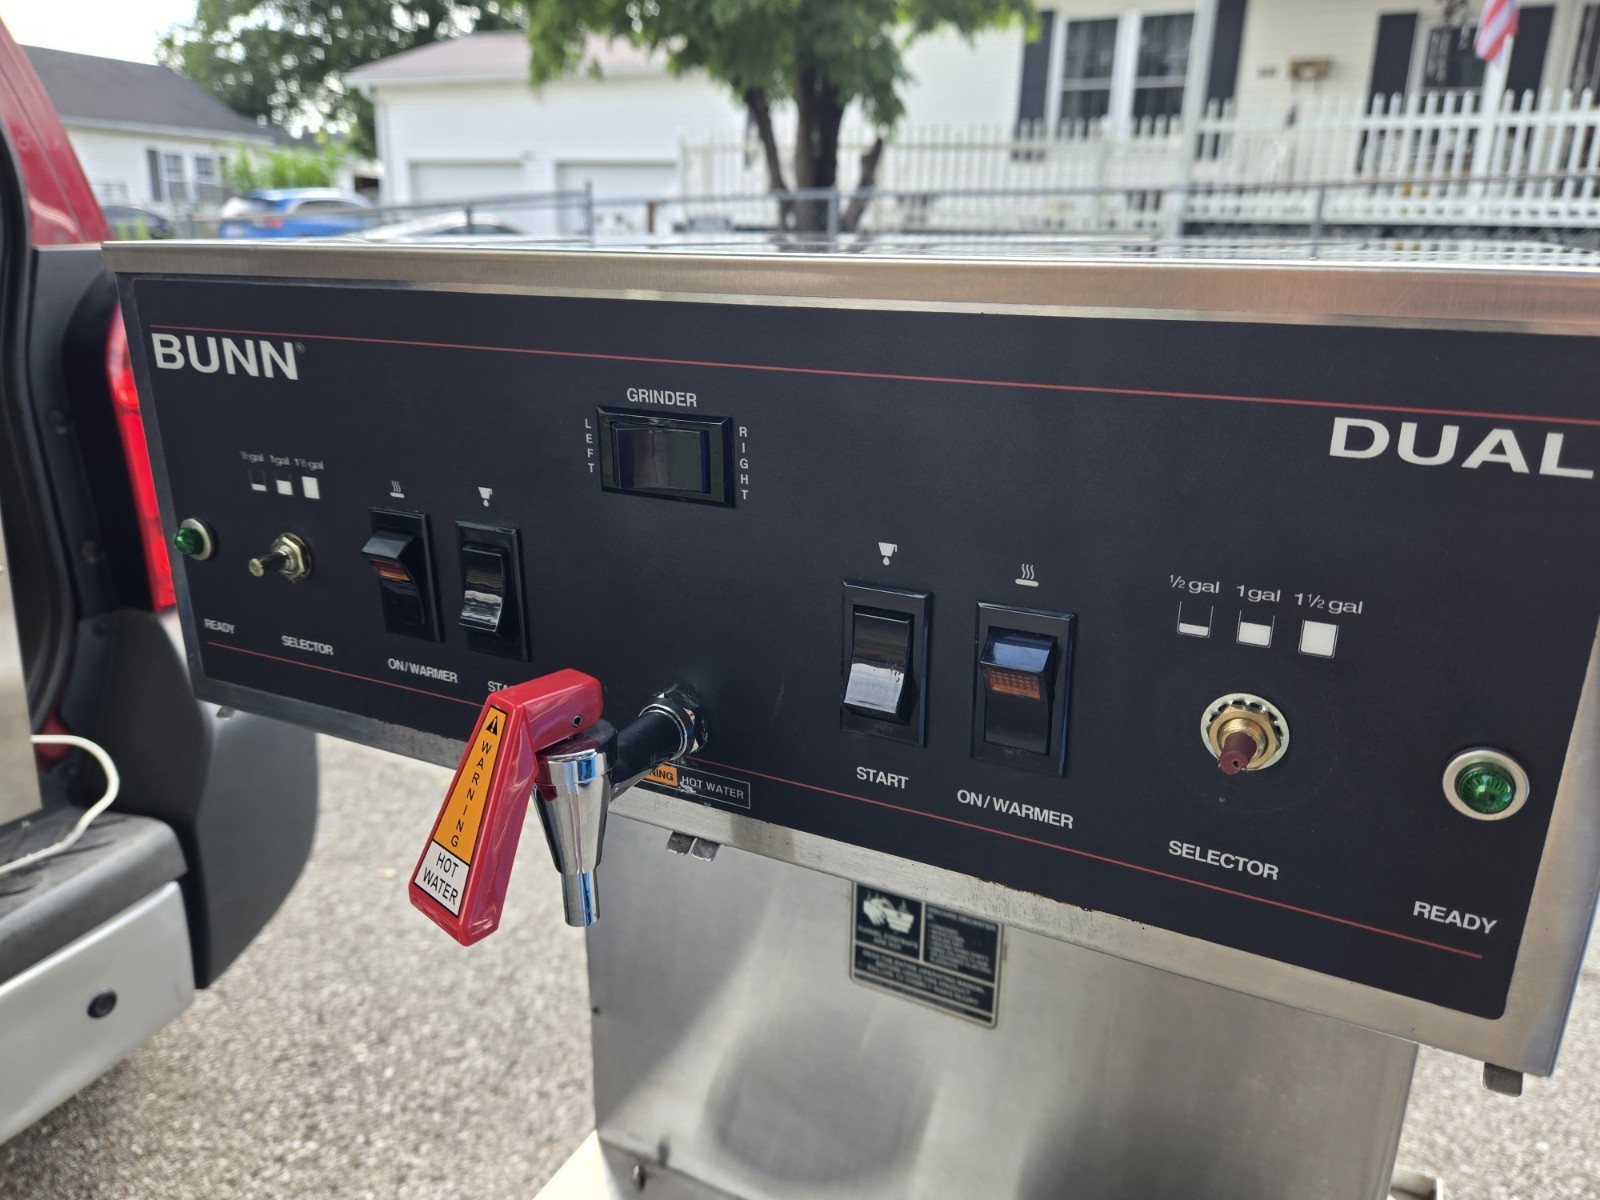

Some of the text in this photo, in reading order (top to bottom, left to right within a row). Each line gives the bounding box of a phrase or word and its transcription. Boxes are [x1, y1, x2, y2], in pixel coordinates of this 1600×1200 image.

[626, 387, 697, 408] GRINDER
[584, 418, 595, 473] LEFT
[1329, 416, 1594, 479] DUAL
[738, 426, 749, 500] RIGHT
[1188, 580, 1220, 594] gal
[1328, 600, 1363, 615] gal
[204, 618, 235, 634] READY
[281, 635, 334, 656] SELECTOR
[451, 740, 493, 848] WARNING
[681, 775, 704, 790] HOT
[705, 781, 744, 800] WATER
[856, 766, 909, 789] START
[436, 851, 459, 878] HOT
[1168, 840, 1279, 880] SELECTOR
[423, 867, 458, 906] WATER
[1413, 900, 1497, 934] READY
